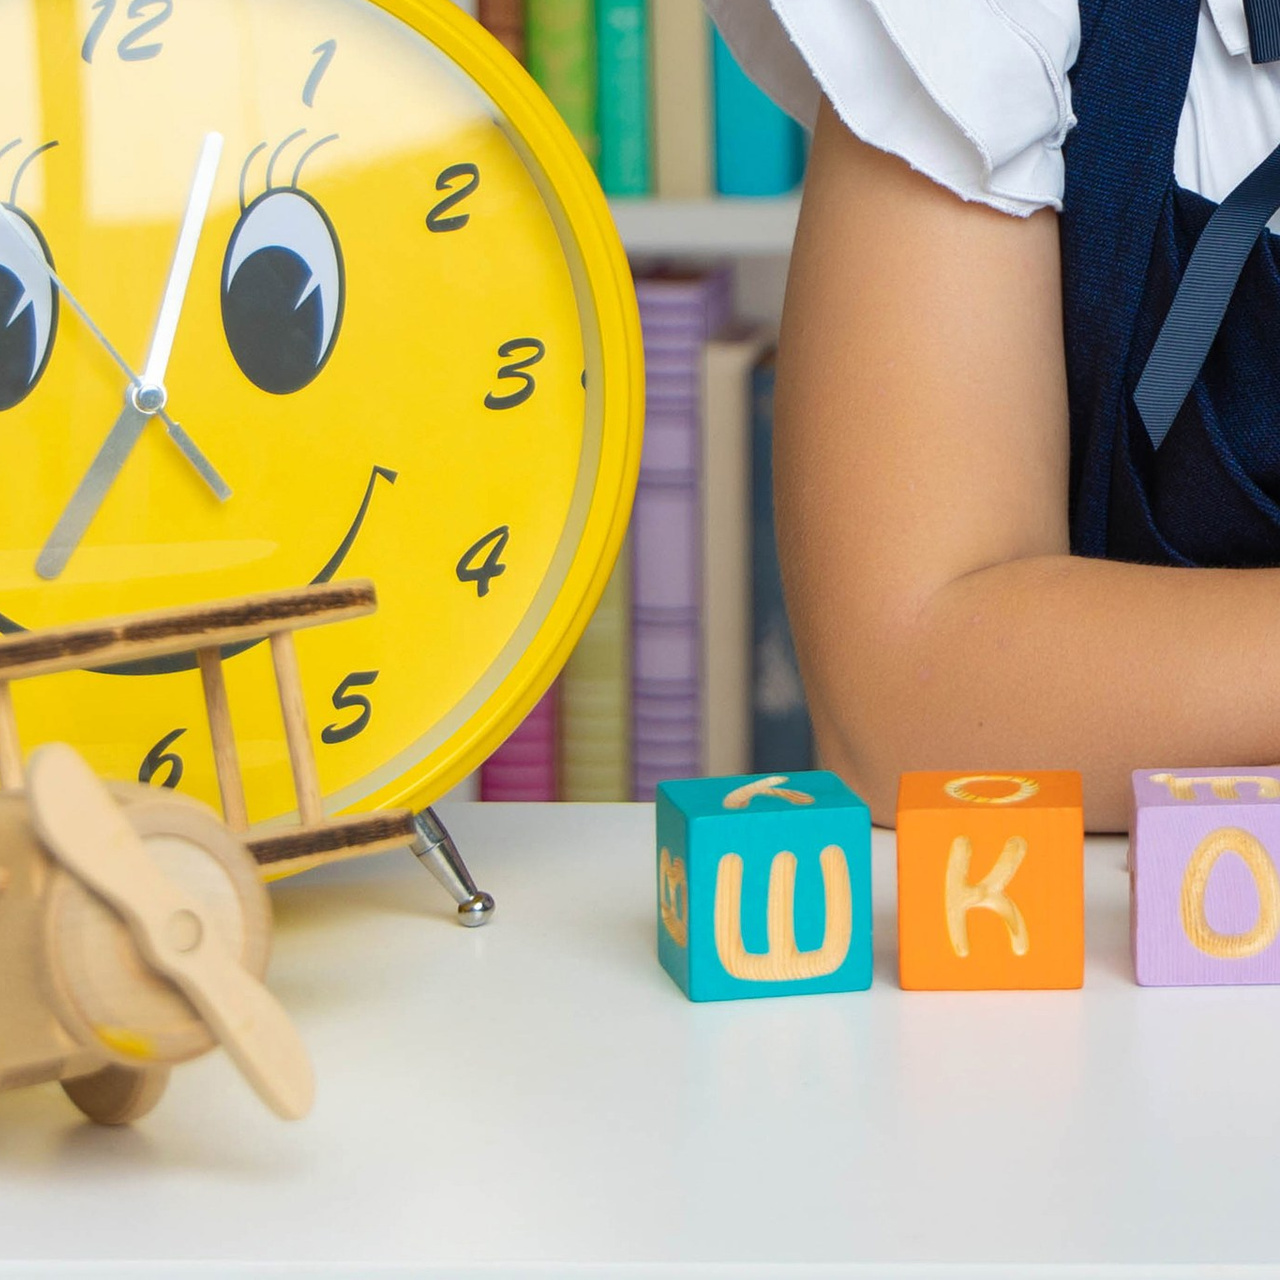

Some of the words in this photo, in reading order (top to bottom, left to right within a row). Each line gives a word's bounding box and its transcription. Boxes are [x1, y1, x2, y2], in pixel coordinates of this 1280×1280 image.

[301, 39, 337, 108] 1
[425, 163, 480, 233] 2
[484, 338, 546, 411] 3
[456, 525, 510, 598] 4
[321, 670, 380, 745] 5
[138, 727, 188, 790] 6
